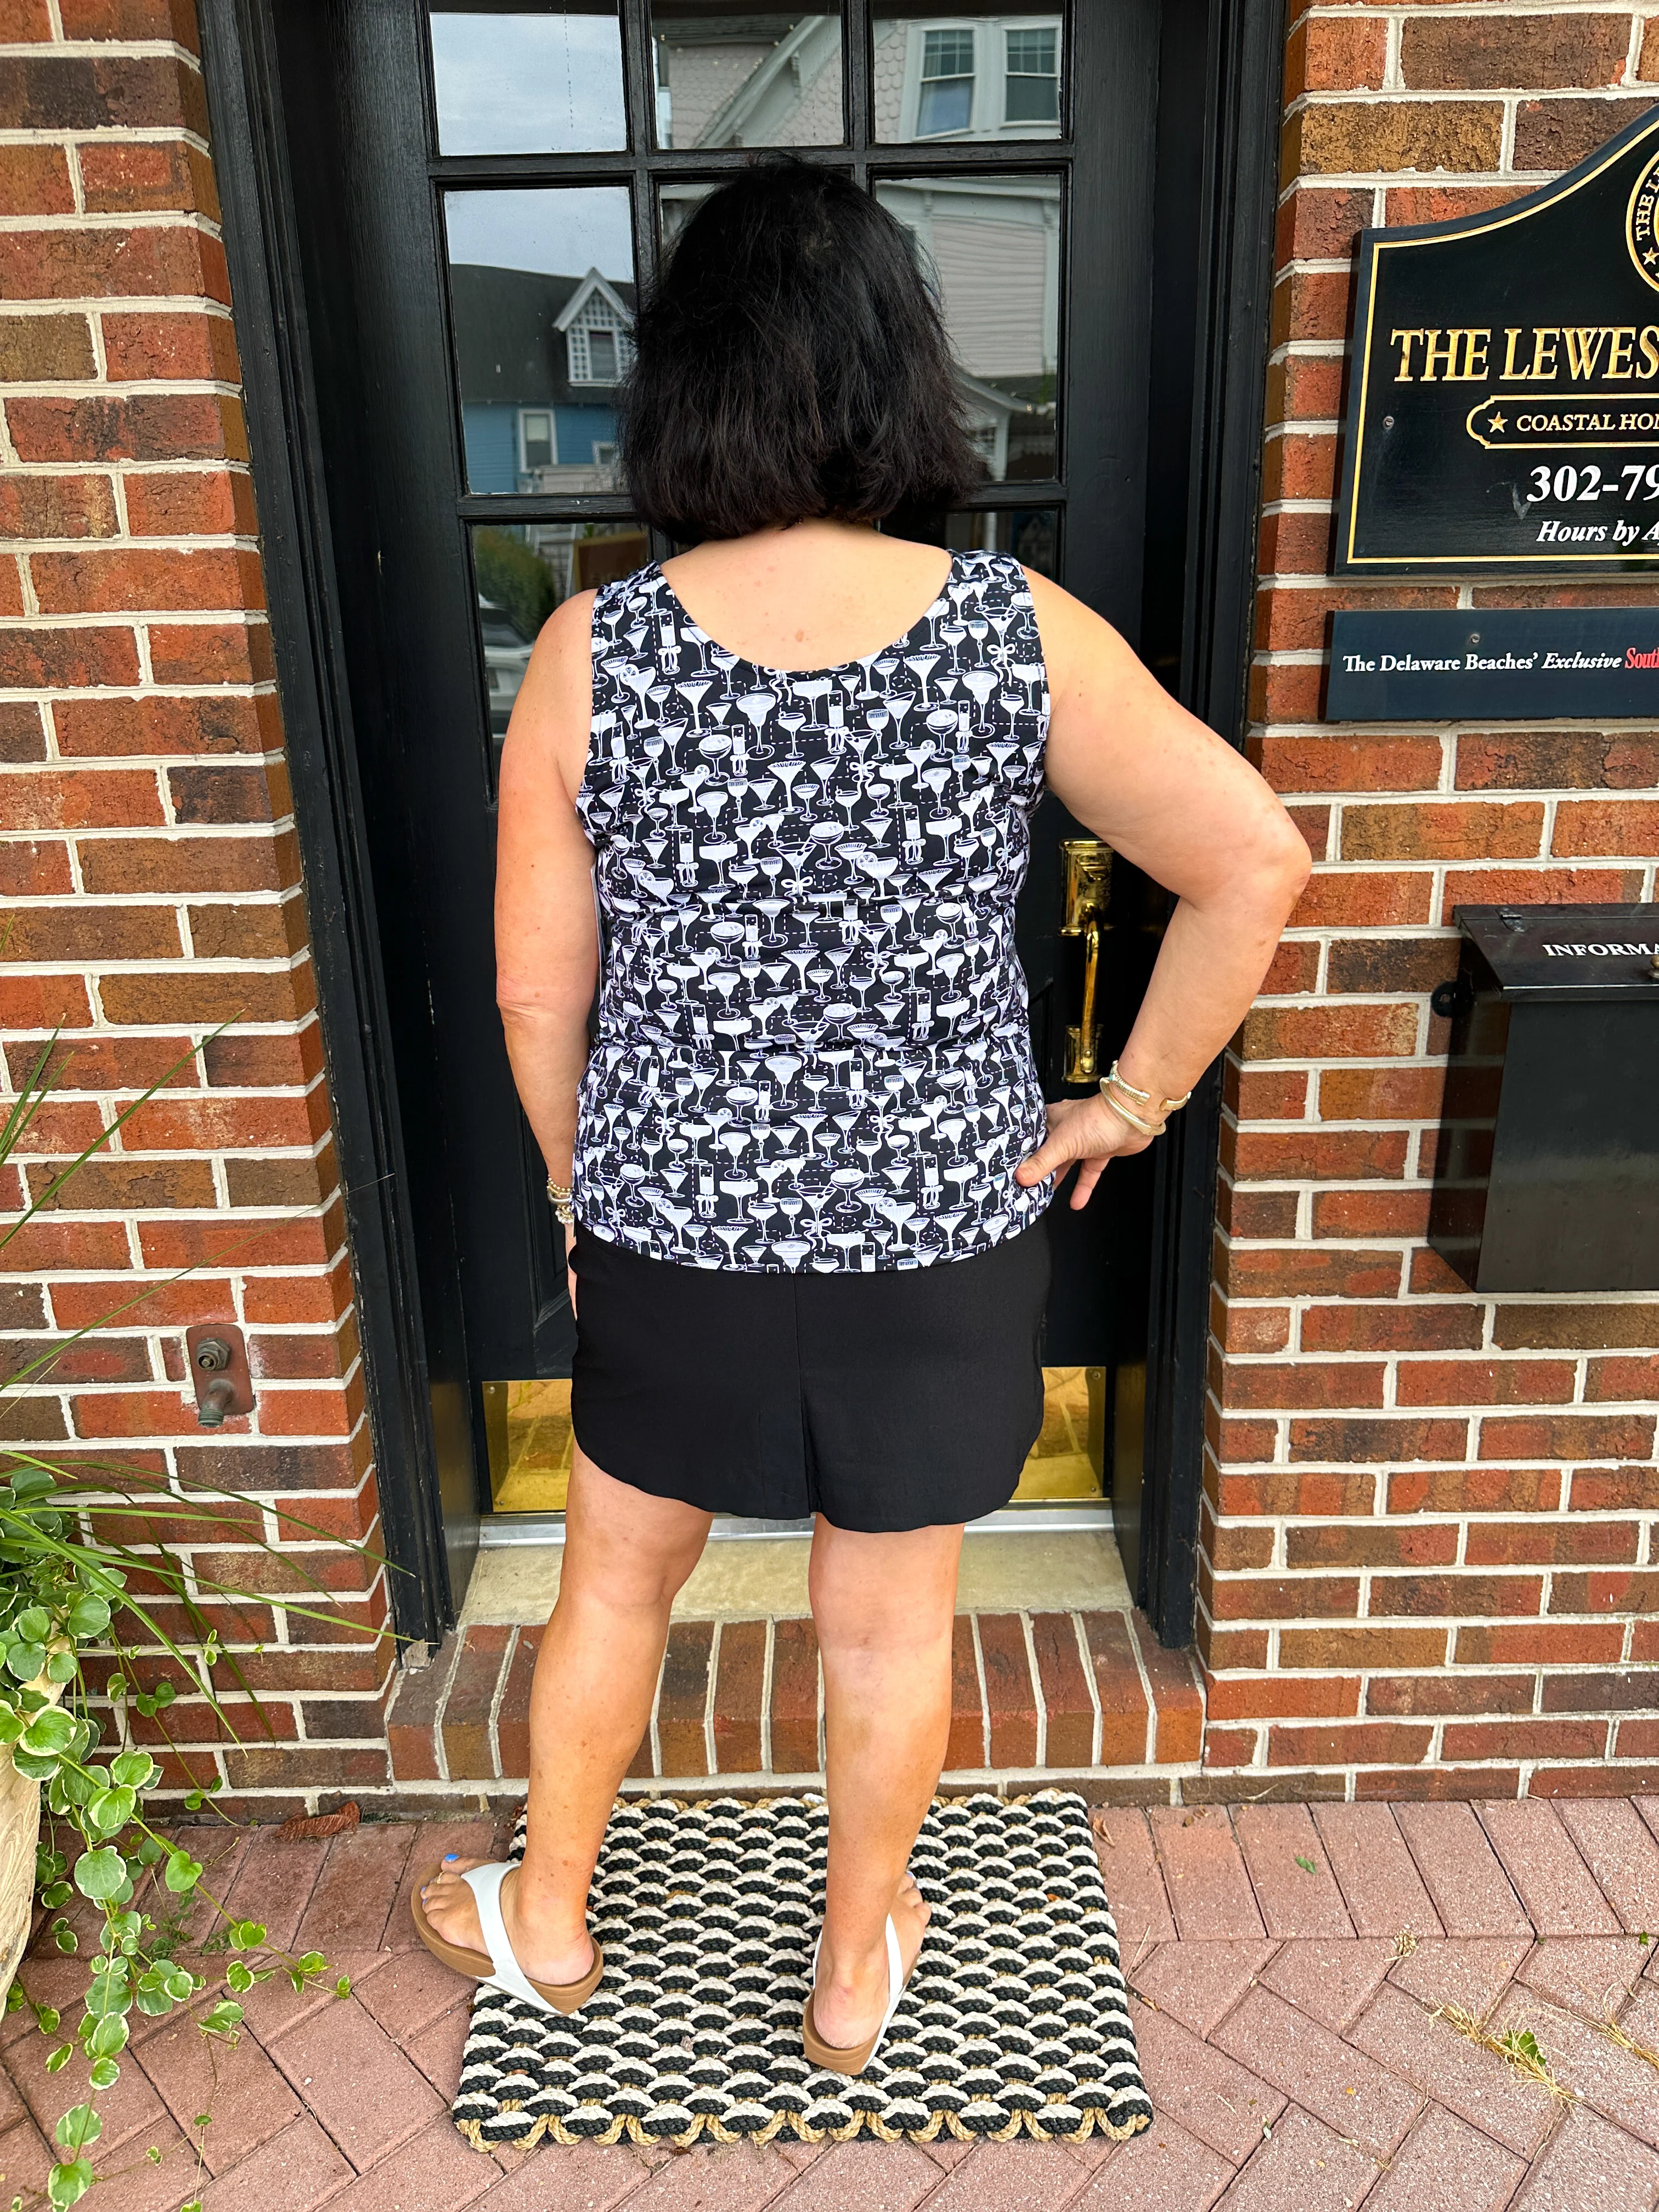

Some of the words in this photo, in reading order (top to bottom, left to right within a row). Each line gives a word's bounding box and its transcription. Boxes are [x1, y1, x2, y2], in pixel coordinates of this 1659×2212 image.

[1390, 329, 1491, 382] THE
[1499, 326, 1659, 380] LEWES
[1516, 414, 1616, 432] COASTAL
[1618, 413, 1659, 431] HO
[1536, 521, 1608, 542] Hours
[1612, 520, 1640, 546] by
[1342, 654, 1375, 672] The
[1379, 653, 1461, 672] Delaware
[1541, 651, 1622, 669] Exclusive
[1624, 647, 1659, 669] Sout
